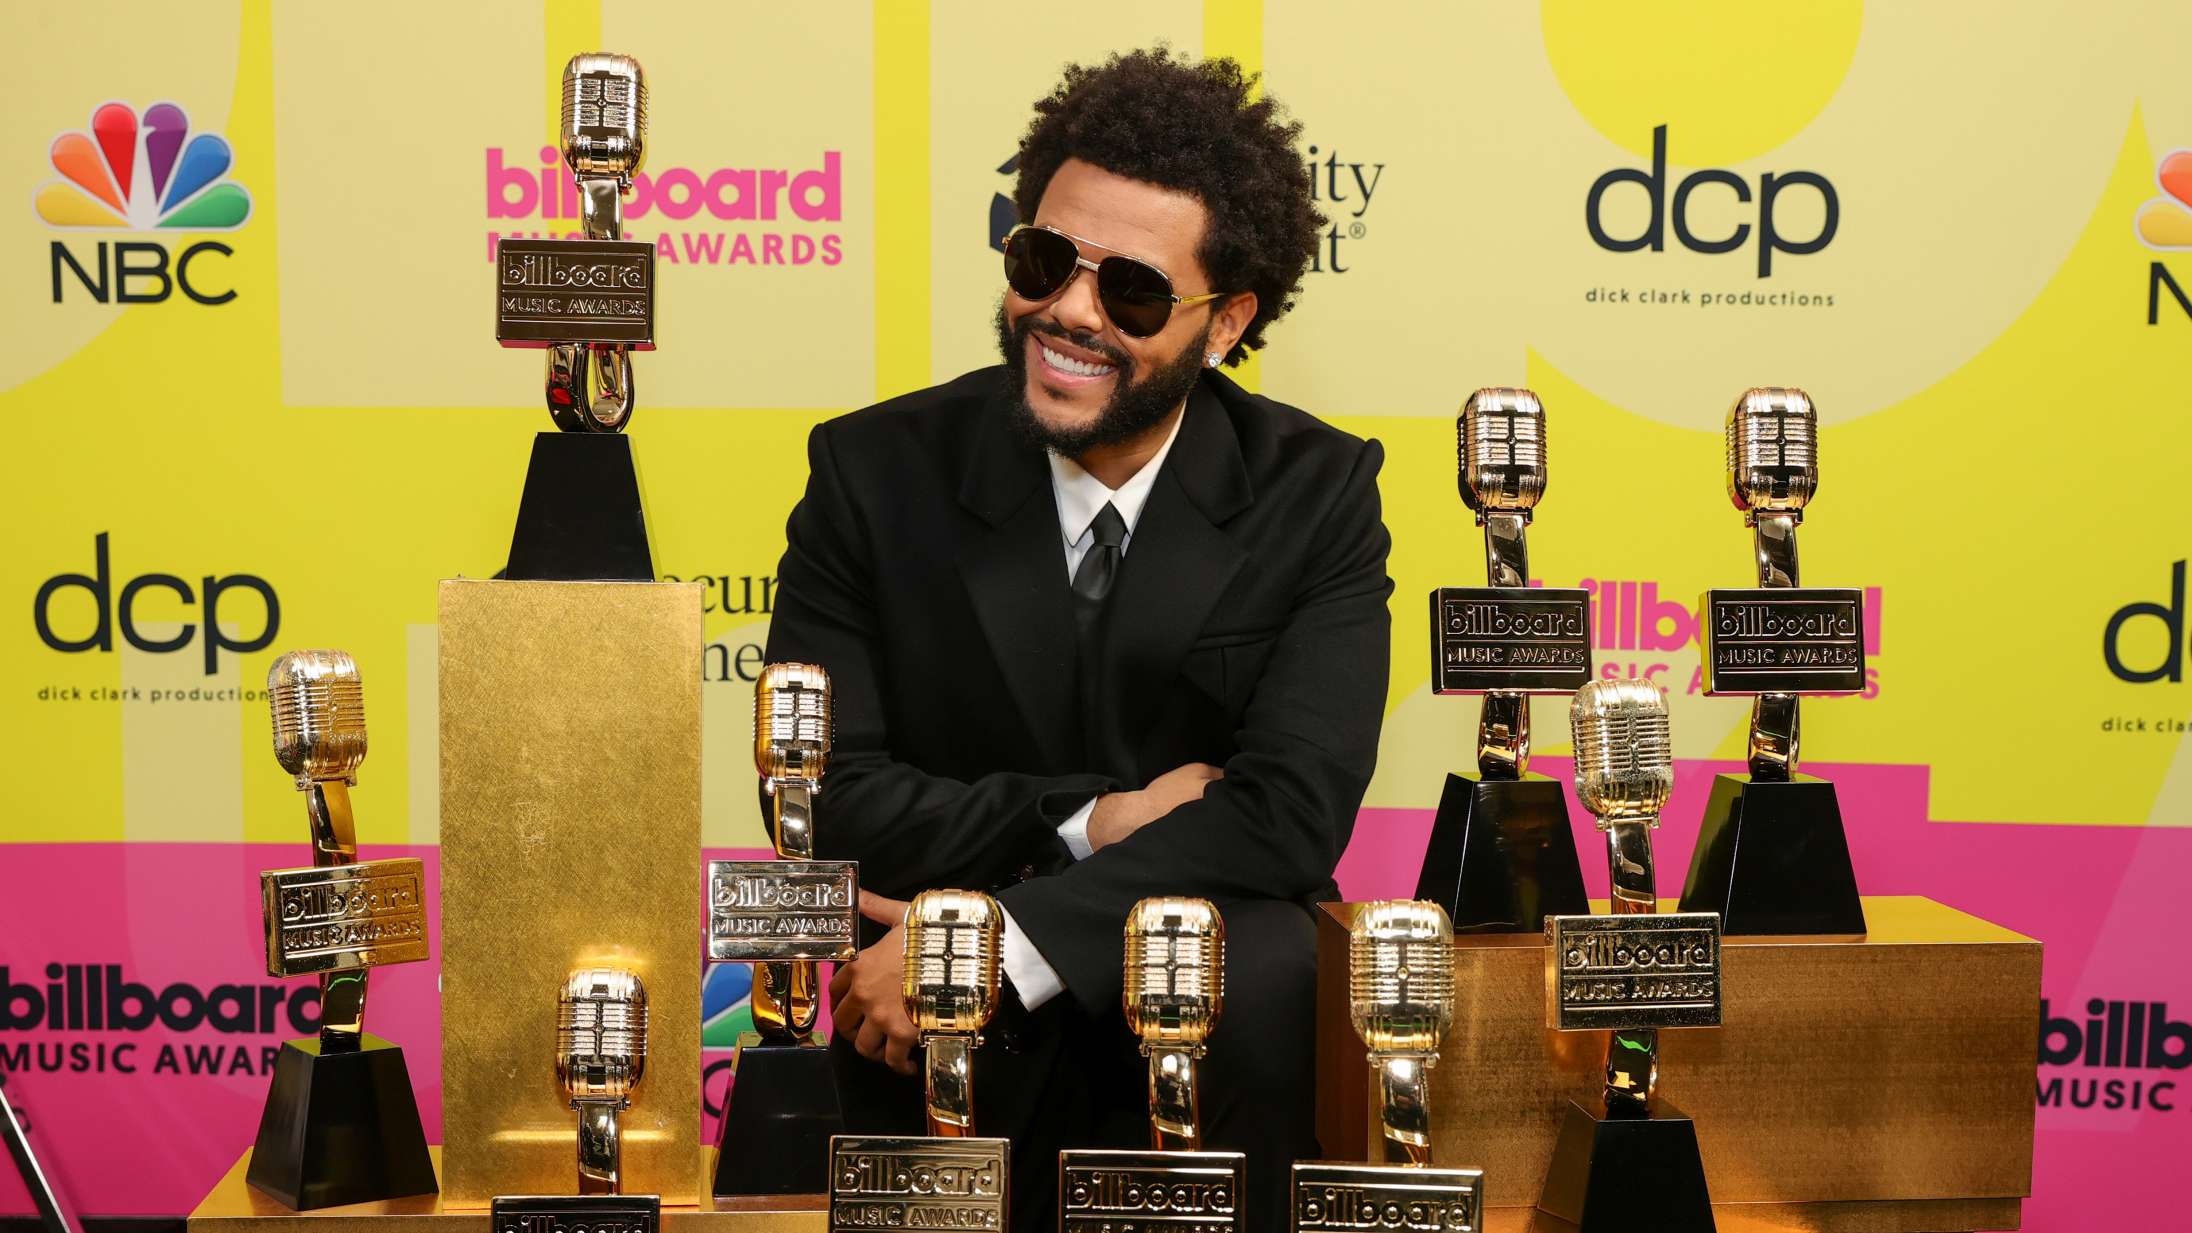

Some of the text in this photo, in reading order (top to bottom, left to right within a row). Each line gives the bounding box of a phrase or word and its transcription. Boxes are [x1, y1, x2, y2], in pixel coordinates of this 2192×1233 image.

[486, 146, 842, 222] biloard
[1586, 124, 1840, 279] dcp
[656, 232, 843, 265] AWARDS
[51, 241, 238, 305] NBC
[503, 254, 646, 288] billboard
[502, 297, 646, 316] MUSIC AWARDS
[1585, 288, 1834, 308] dick clark productions
[34, 531, 280, 675] dcp
[1446, 604, 1584, 636] billboard
[1717, 606, 1856, 636] billboard
[1448, 647, 1584, 664] MUSIC AWARDS
[1719, 648, 1857, 664] MUSIC AWARDS
[37, 686, 270, 704] dick clark production
[2101, 716, 2192, 733] dick cla
[281, 877, 419, 921] billboard
[714, 876, 853, 907] billboard
[284, 920, 420, 949] MUSIC AWARDS
[714, 918, 852, 934] MUSIC AWARDS
[1563, 933, 1713, 969] billboard
[1563, 980, 1714, 1001] MUSIC AWARDS
[2037, 998, 2192, 1070] billb
[0, 1043, 278, 1077] MUSIC AWAR
[836, 1155, 1000, 1195] billboard
[1067, 1172, 1235, 1213] billboard
[834, 1206, 999, 1228] MUSIC AWARDS
[1299, 1187, 1472, 1231] billboard
